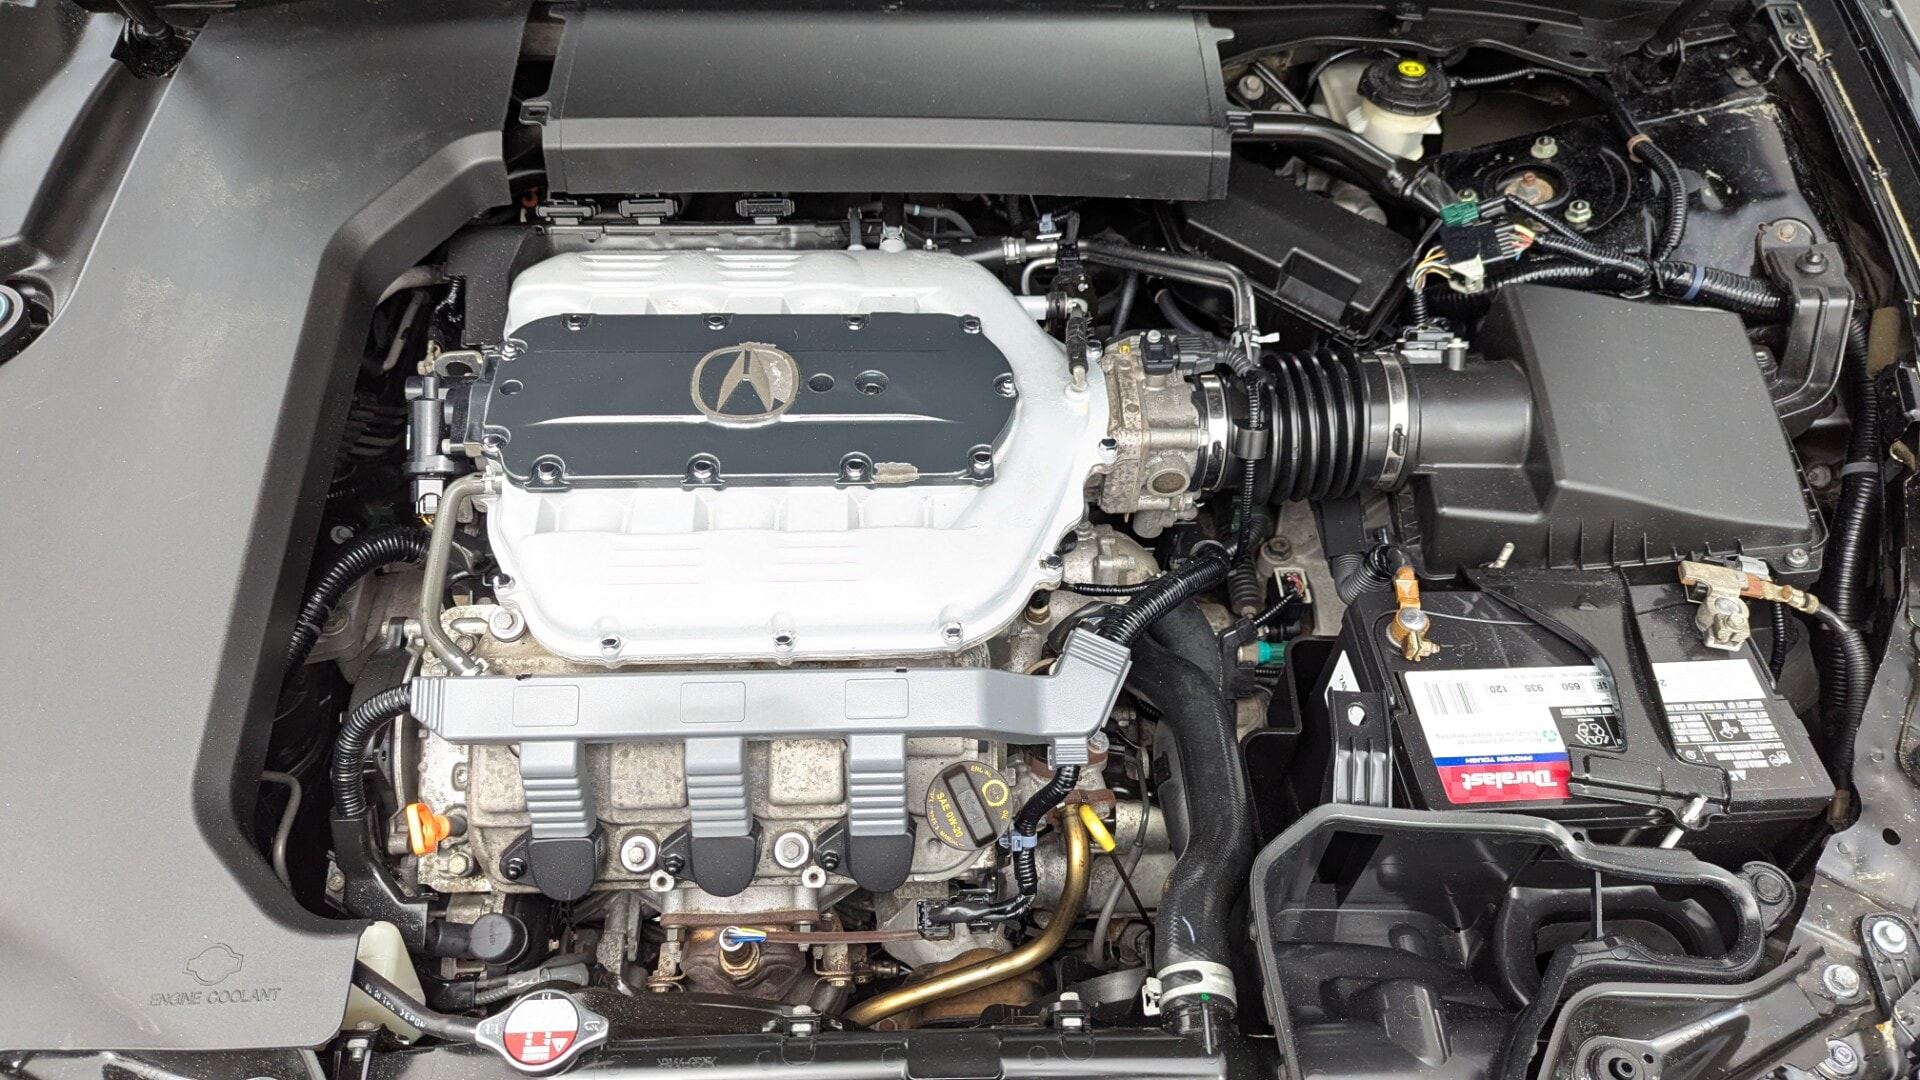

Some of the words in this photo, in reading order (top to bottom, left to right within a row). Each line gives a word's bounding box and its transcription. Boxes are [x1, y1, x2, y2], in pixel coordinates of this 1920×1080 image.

[1489, 684, 1508, 694] 120
[1524, 683, 1544, 693] 935
[1561, 681, 1581, 692] 650
[1465, 756, 1495, 764] TOUGH
[1497, 755, 1534, 763] PROVEN
[1460, 769, 1557, 791] Duralast
[936, 792, 949, 812] SAE
[946, 811, 964, 838] 0W-20
[1001, 809, 1009, 820] OIL
[150, 991, 202, 1007] ENGINE
[207, 987, 281, 1005] COOLANT
